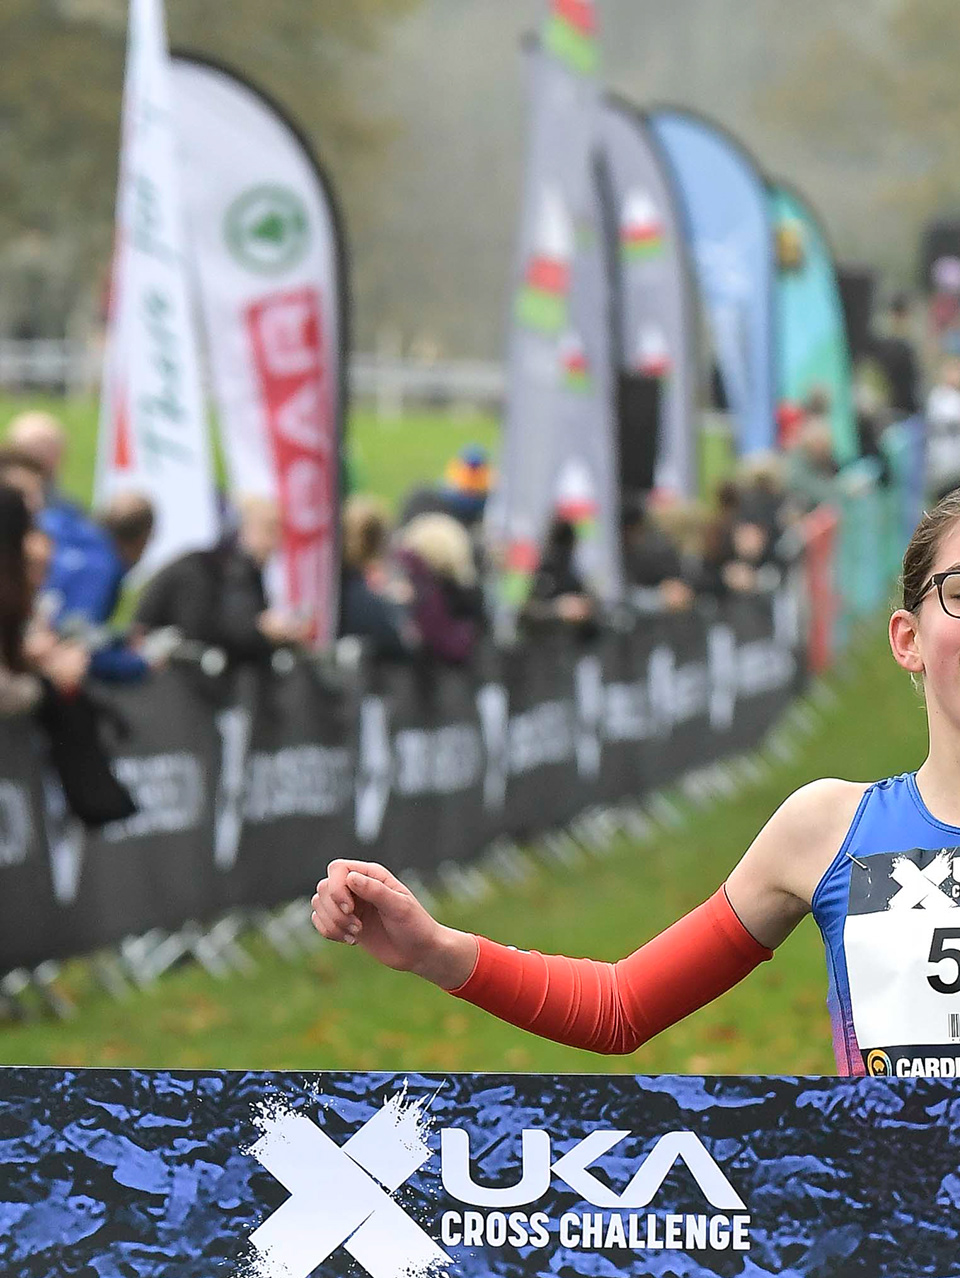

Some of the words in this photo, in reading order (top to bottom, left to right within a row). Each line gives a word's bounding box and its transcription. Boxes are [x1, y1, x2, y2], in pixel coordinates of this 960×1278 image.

[441, 1127, 748, 1210] UKA
[440, 1211, 550, 1248] CROSS
[559, 1213, 751, 1251] CHALLENGE
